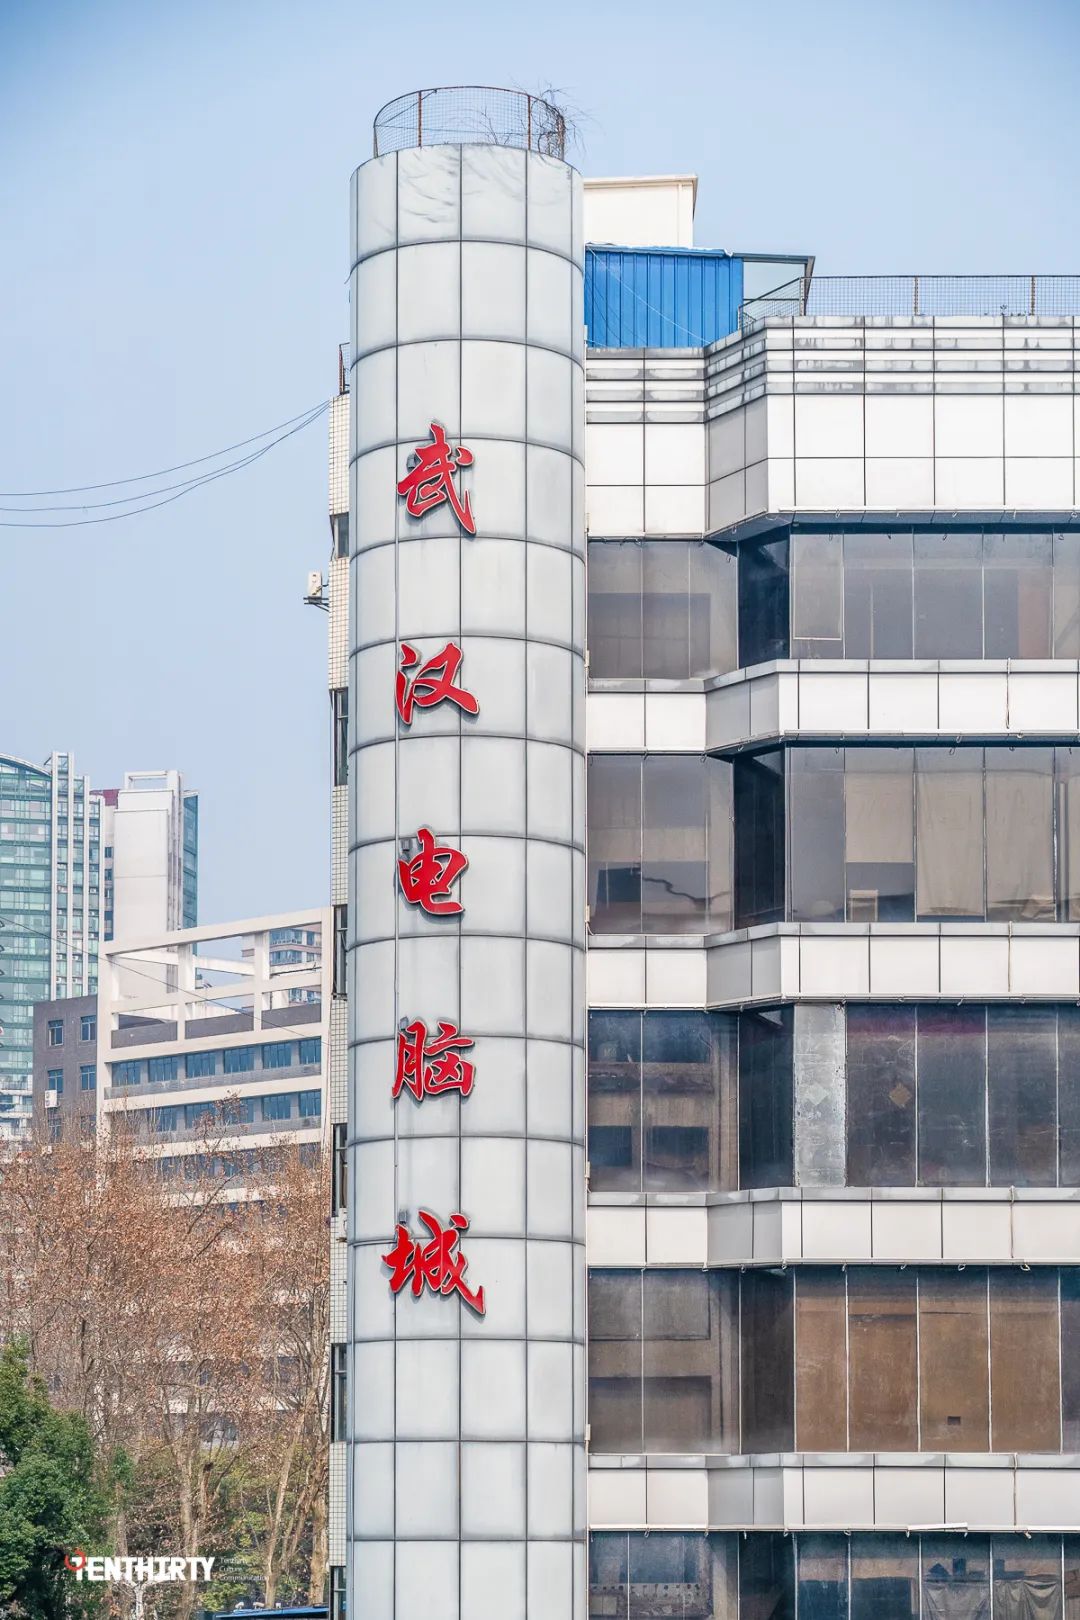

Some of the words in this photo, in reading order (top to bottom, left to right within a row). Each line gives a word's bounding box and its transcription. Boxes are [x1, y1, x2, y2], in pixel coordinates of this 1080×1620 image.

[382, 423, 485, 1314] 武汉电脑城
